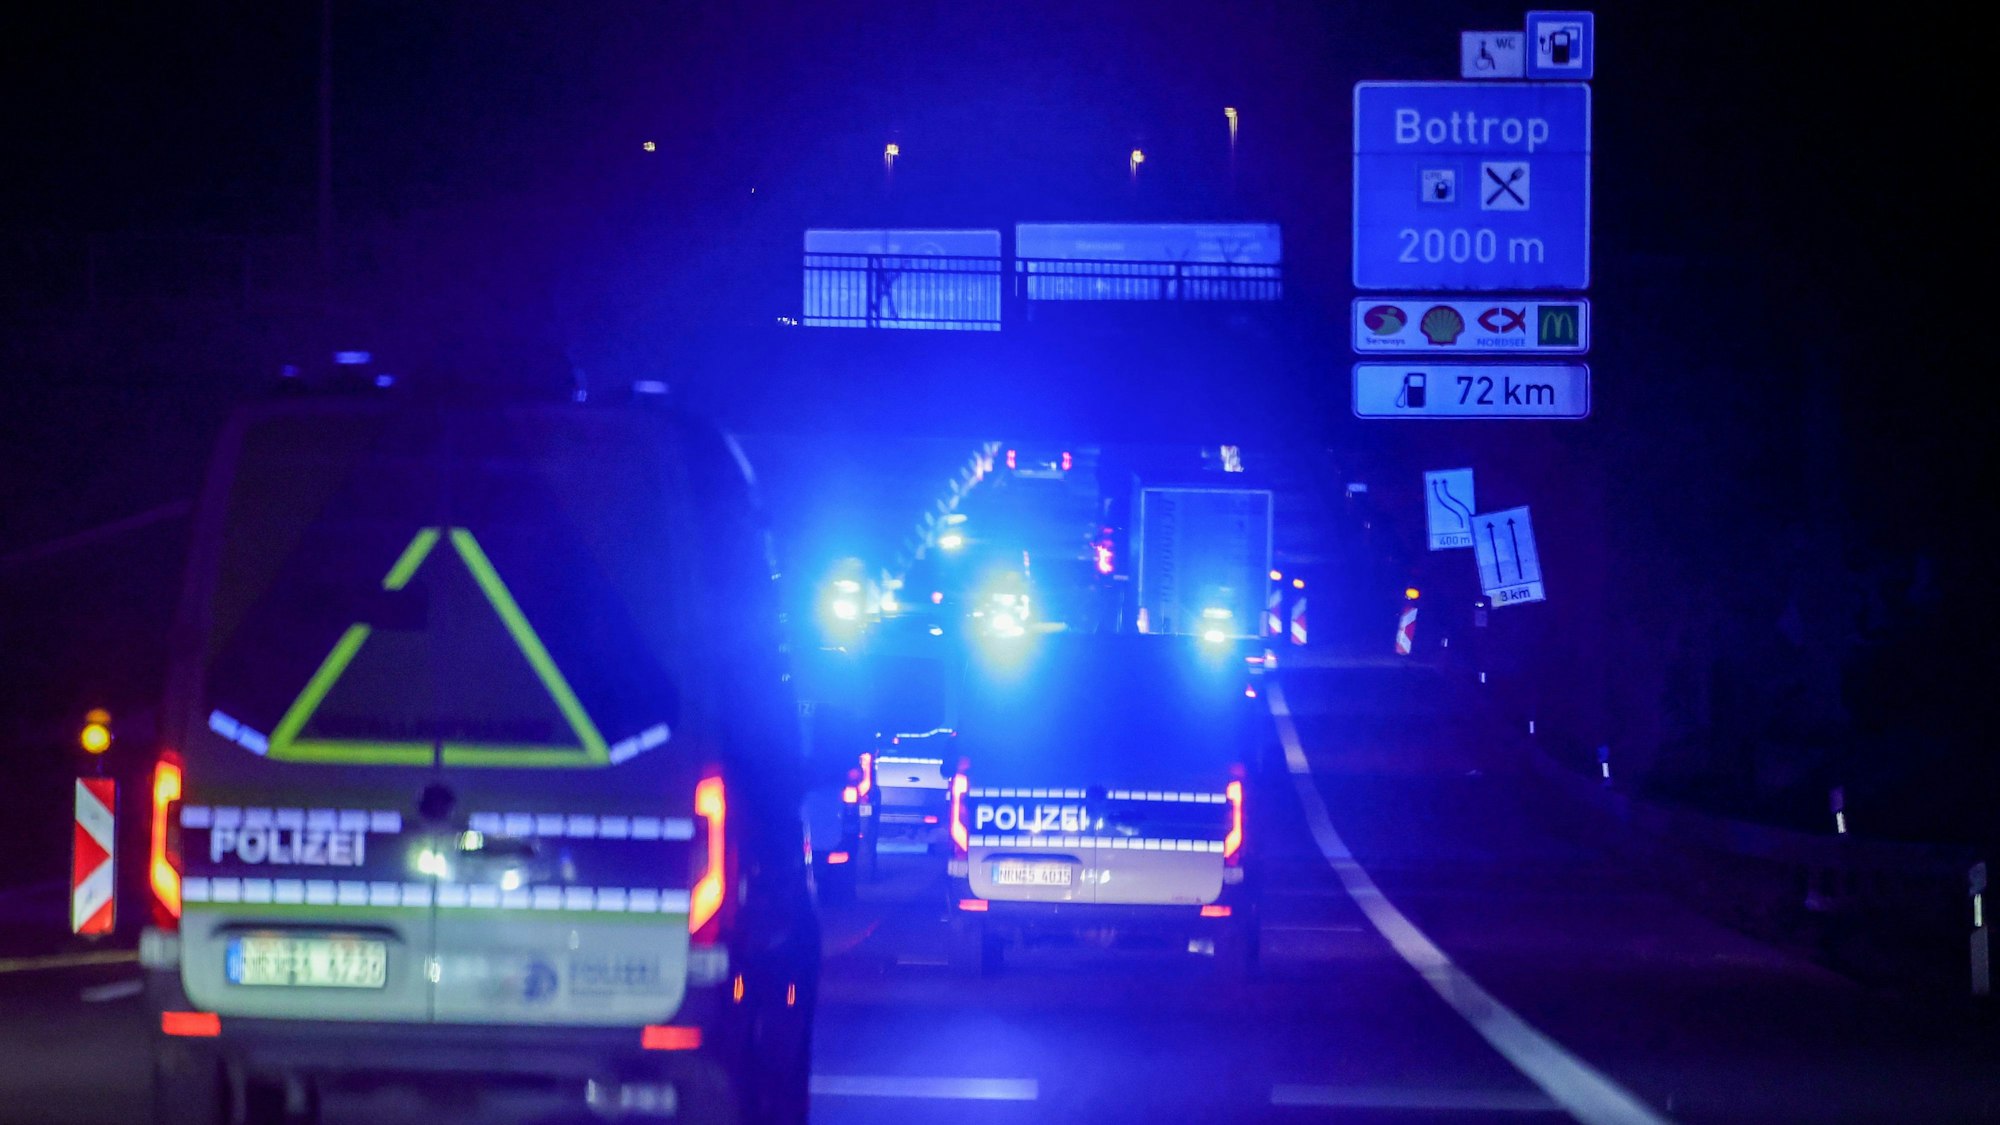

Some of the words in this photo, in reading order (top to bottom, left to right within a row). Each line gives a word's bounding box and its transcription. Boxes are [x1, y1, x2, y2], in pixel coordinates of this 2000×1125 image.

[1496, 38, 1515, 49] WC
[1396, 109, 1549, 153] Bottrop
[1399, 229, 1496, 264] 2000
[1509, 237, 1544, 263] m
[1477, 338, 1525, 347] NORDSEE
[1457, 376, 1493, 405] 72
[1504, 376, 1554, 405] km
[1439, 537, 1458, 545] 400
[1461, 536, 1470, 544] m
[1501, 591, 1508, 601] 3
[1511, 587, 1530, 599] km
[976, 804, 1087, 832] POLIZEI
[210, 826, 365, 866] POLIZEI
